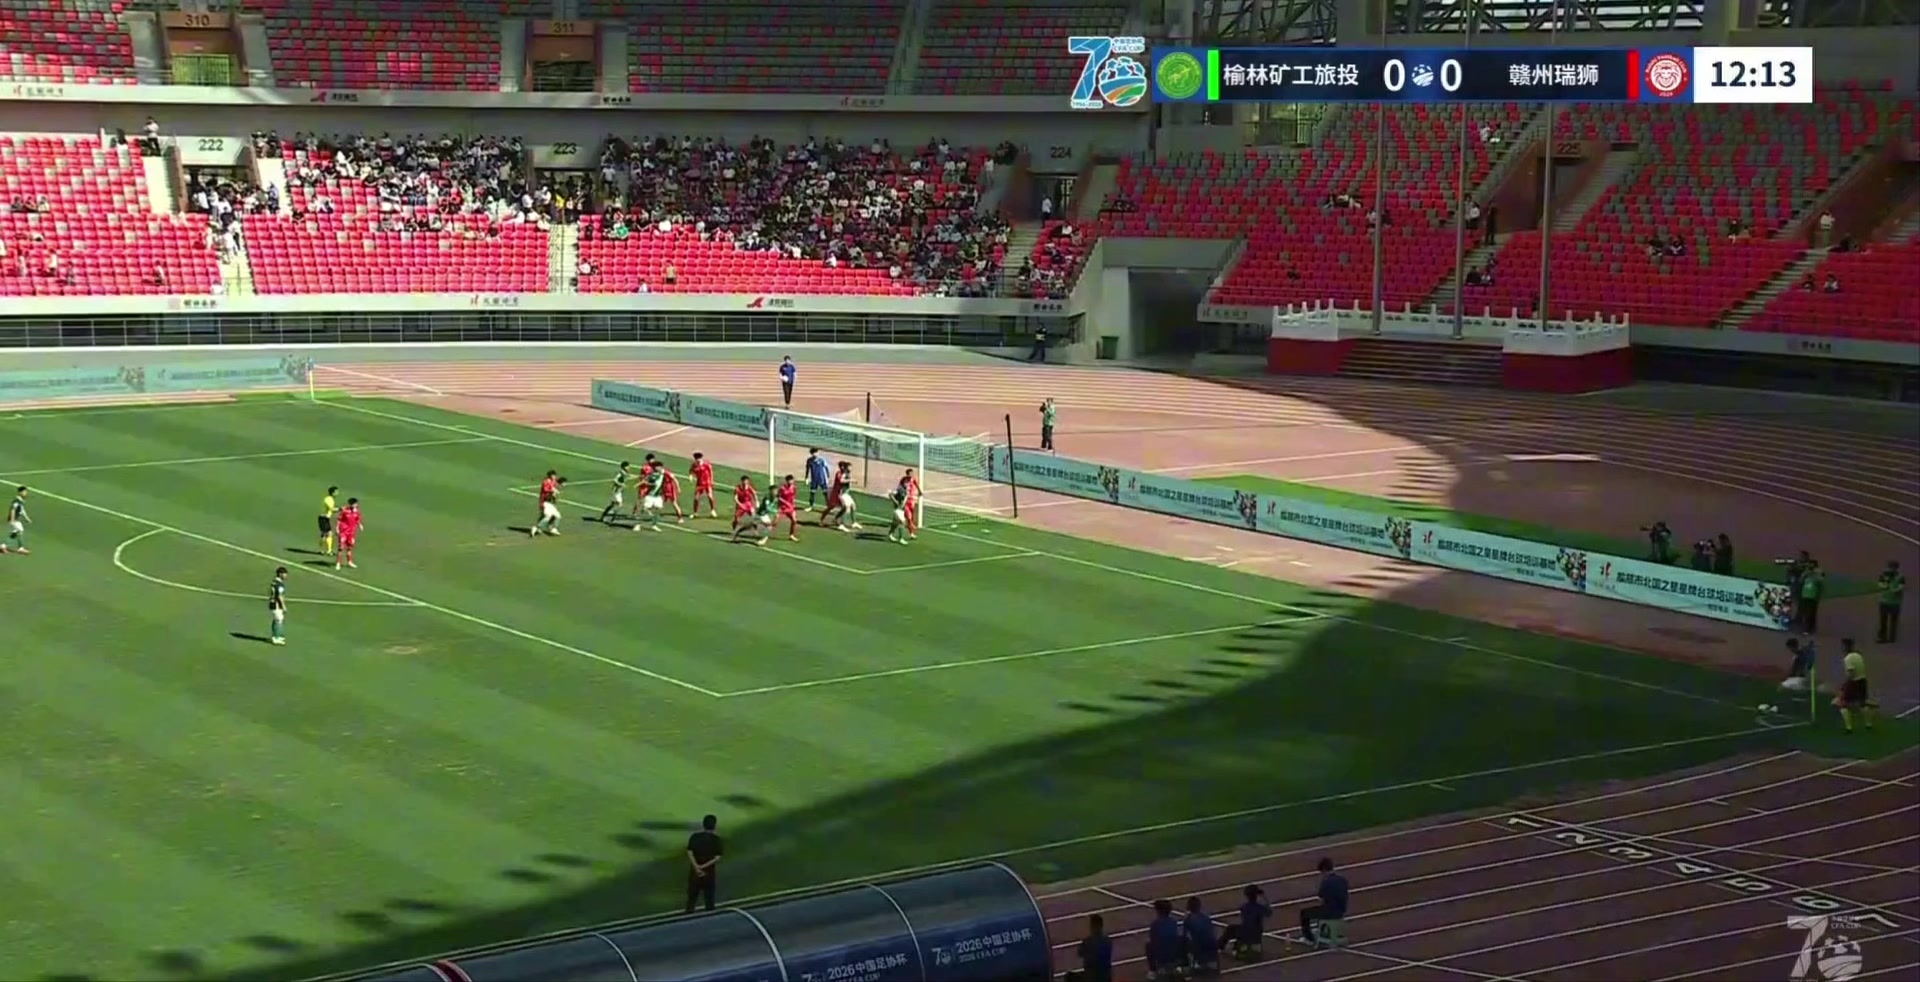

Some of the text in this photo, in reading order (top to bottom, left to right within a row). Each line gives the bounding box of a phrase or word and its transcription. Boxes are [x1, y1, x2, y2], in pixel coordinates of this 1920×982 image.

[185, 14, 210, 27] 310
[554, 22, 575, 33] 311
[198, 138, 224, 152] 222
[553, 142, 577, 155] 223
[1050, 146, 1072, 159] 224
[1508, 817, 1542, 828] 1
[1556, 832, 1602, 845] 2
[1608, 846, 1654, 859] 3
[1675, 861, 1713, 874] 4
[1722, 877, 1772, 891] 5
[1791, 895, 1841, 910] 6
